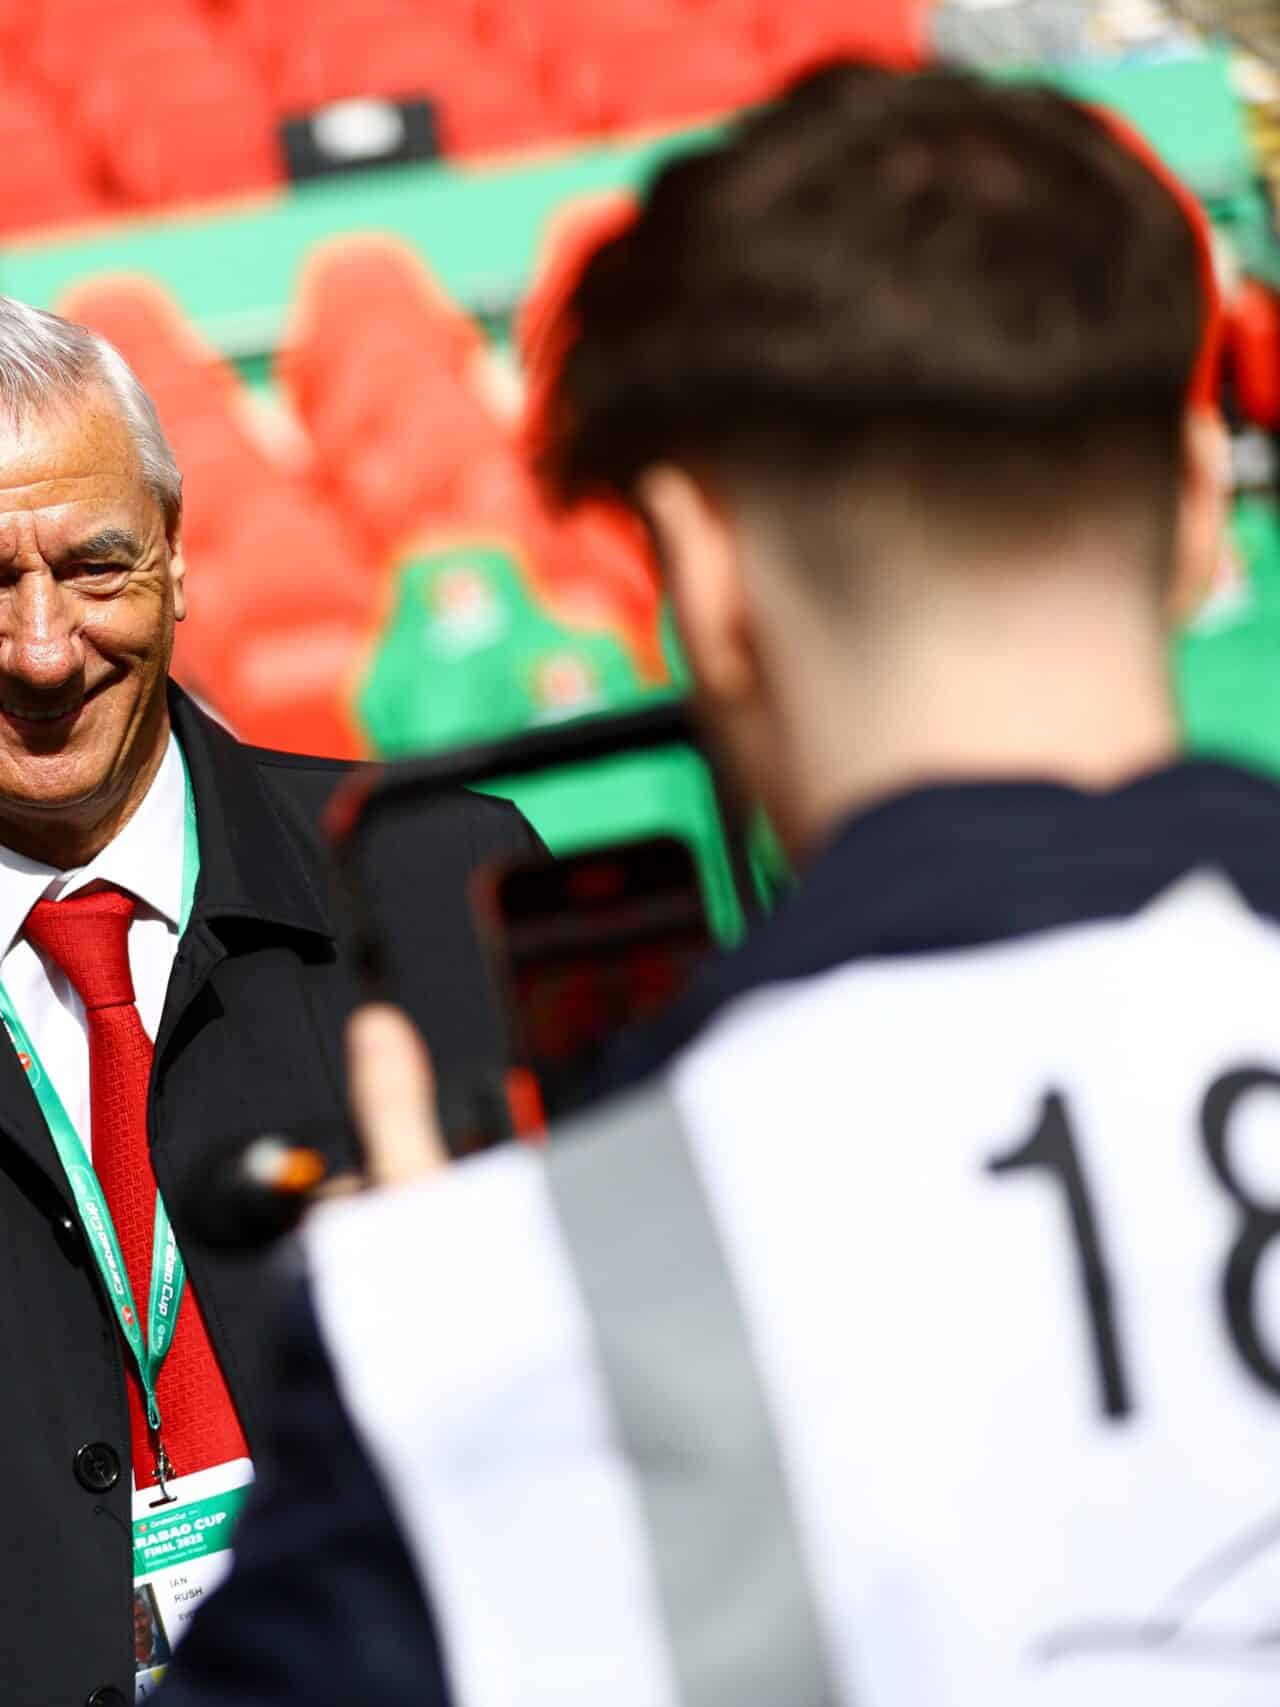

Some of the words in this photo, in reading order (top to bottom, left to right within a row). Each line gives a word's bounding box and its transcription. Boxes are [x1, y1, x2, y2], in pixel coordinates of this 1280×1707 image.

[159, 1284, 173, 1316] Cup
[133, 1523, 192, 1551] RABAO
[193, 1511, 227, 1530] CUP
[144, 1541, 176, 1559] FINAL
[170, 1577, 188, 1588] IAN
[174, 1587, 204, 1602] RUSH
